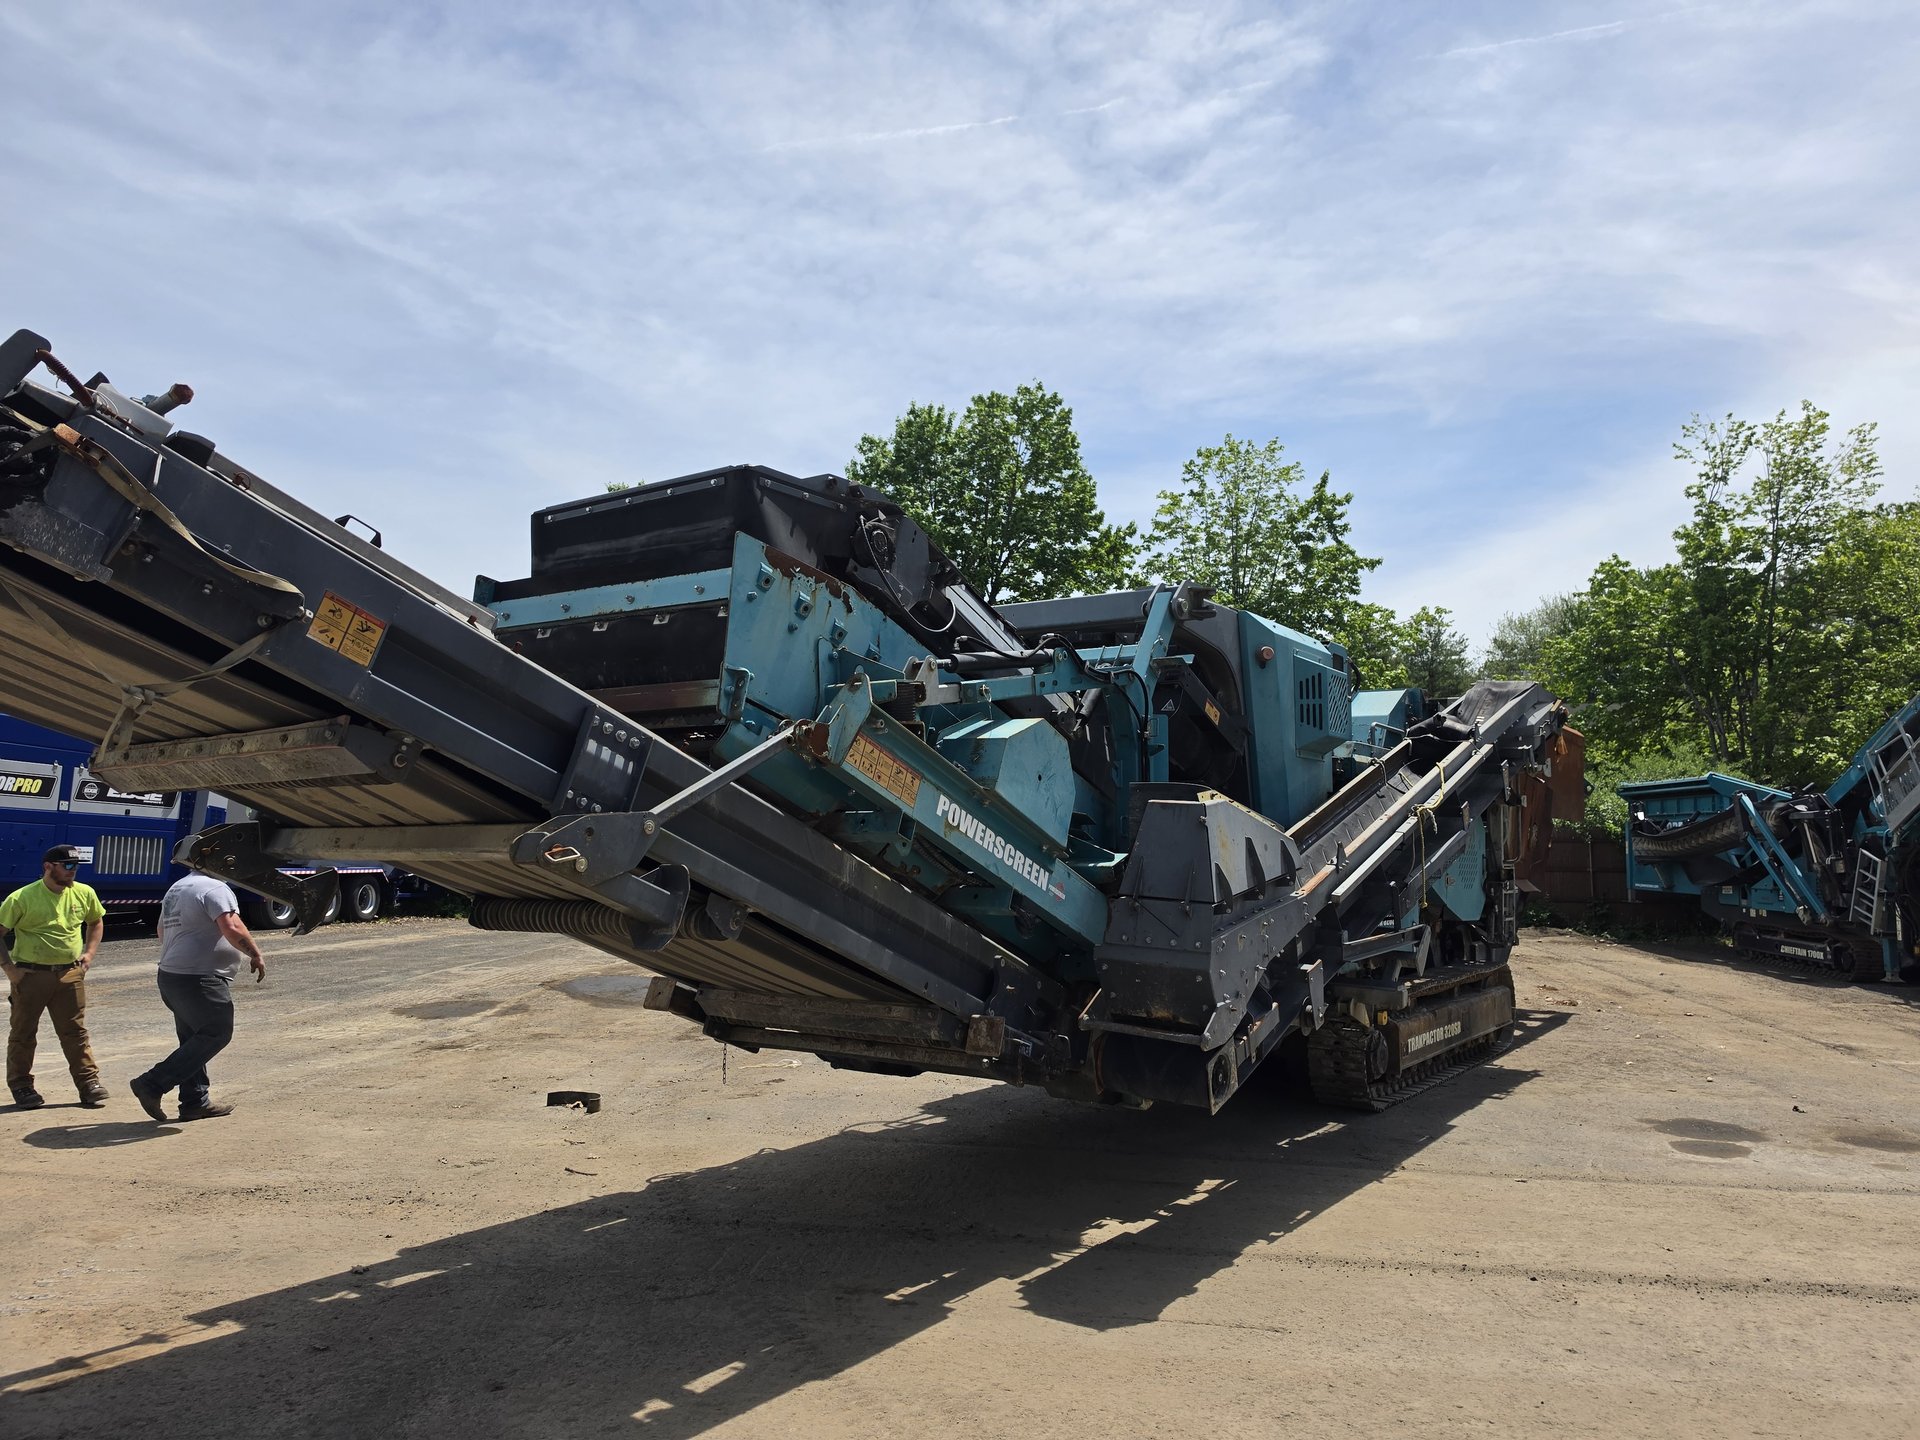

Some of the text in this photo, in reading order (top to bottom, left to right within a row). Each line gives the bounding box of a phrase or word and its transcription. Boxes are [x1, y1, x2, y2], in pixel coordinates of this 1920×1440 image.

[936, 794, 1049, 892] POWERSCREEN
[1780, 945, 1824, 960] CHIEFTAIN 1700X
[1407, 1027, 1444, 1053] TRAKPACTOR
